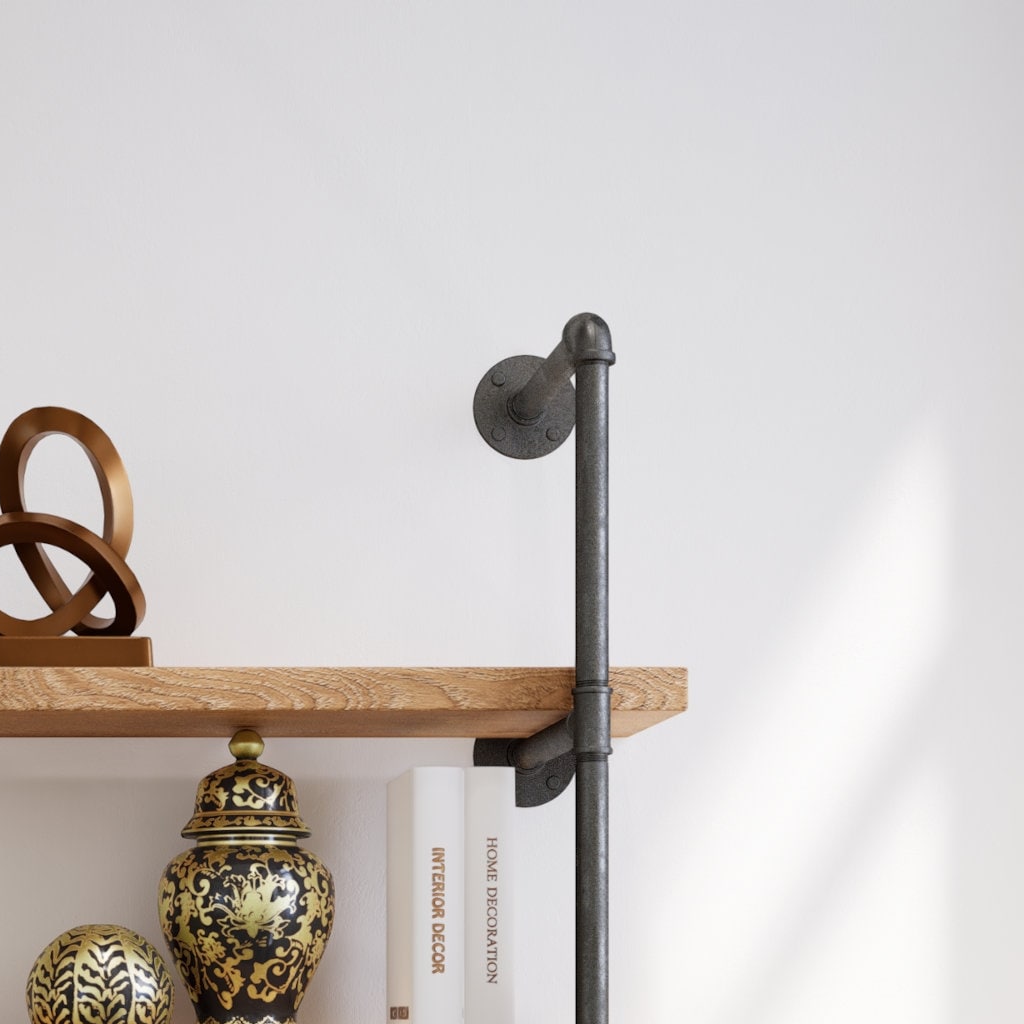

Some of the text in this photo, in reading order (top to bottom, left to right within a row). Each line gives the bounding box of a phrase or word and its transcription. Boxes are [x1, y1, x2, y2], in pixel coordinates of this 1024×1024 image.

[432, 847, 445, 974] INTERIOR DECOR
[486, 837, 498, 985] HOME DECORATION
